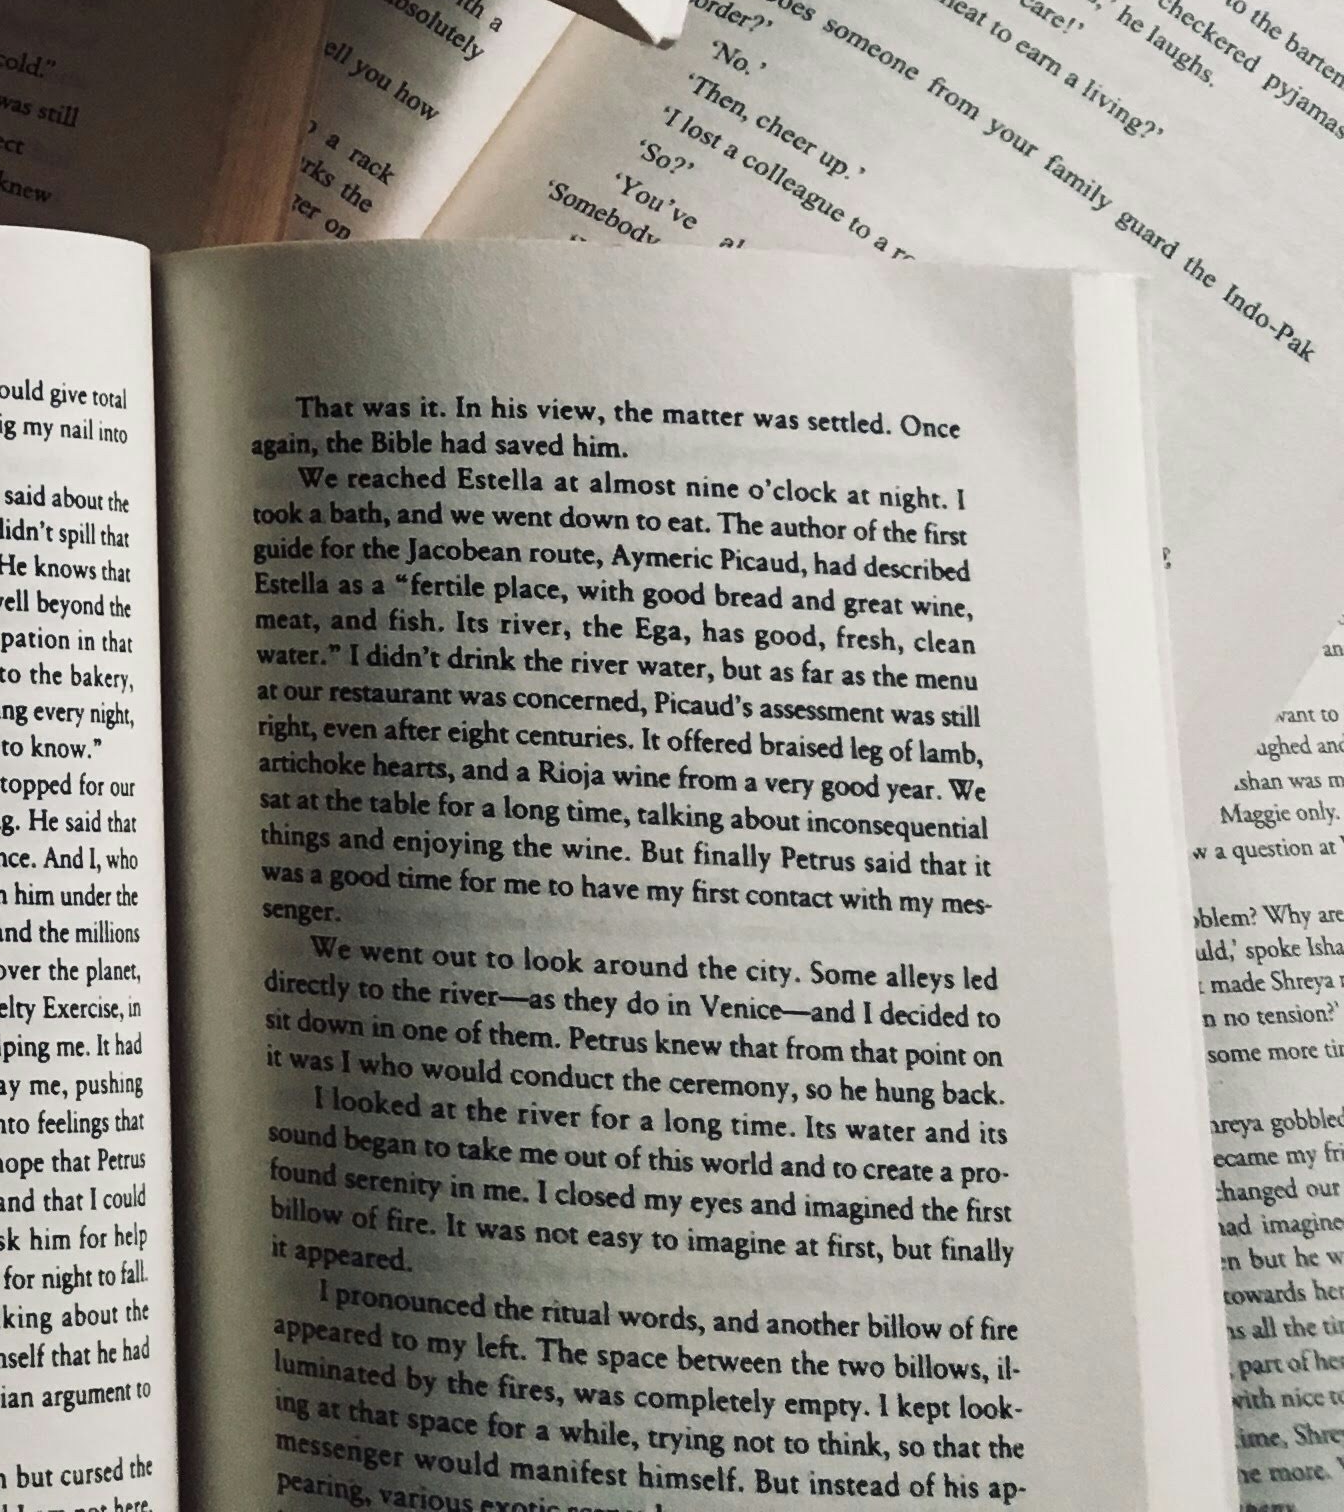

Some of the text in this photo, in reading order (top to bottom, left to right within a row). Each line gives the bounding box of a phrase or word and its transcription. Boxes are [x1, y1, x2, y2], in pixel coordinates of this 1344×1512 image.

[346, 58, 440, 121] you how
[989, 20, 1012, 43] to
[1014, 39, 1062, 77] earn
[1063, 72, 1079, 89] a
[1080, 77, 1164, 138] living?’
[687, 72, 748, 123] ‘Then,
[755, 114, 818, 155] cheer
[49, 381, 87, 408] give
[91, 387, 127, 409] total
[294, 394, 960, 439] That was it. In his view, the matter was settled. Once
[1219, 799, 1340, 830] Maggie only.
[261, 901, 342, 927] senger.
[1209, 968, 1335, 995] made Shreya
[1206, 1044, 1319, 1064] some more
